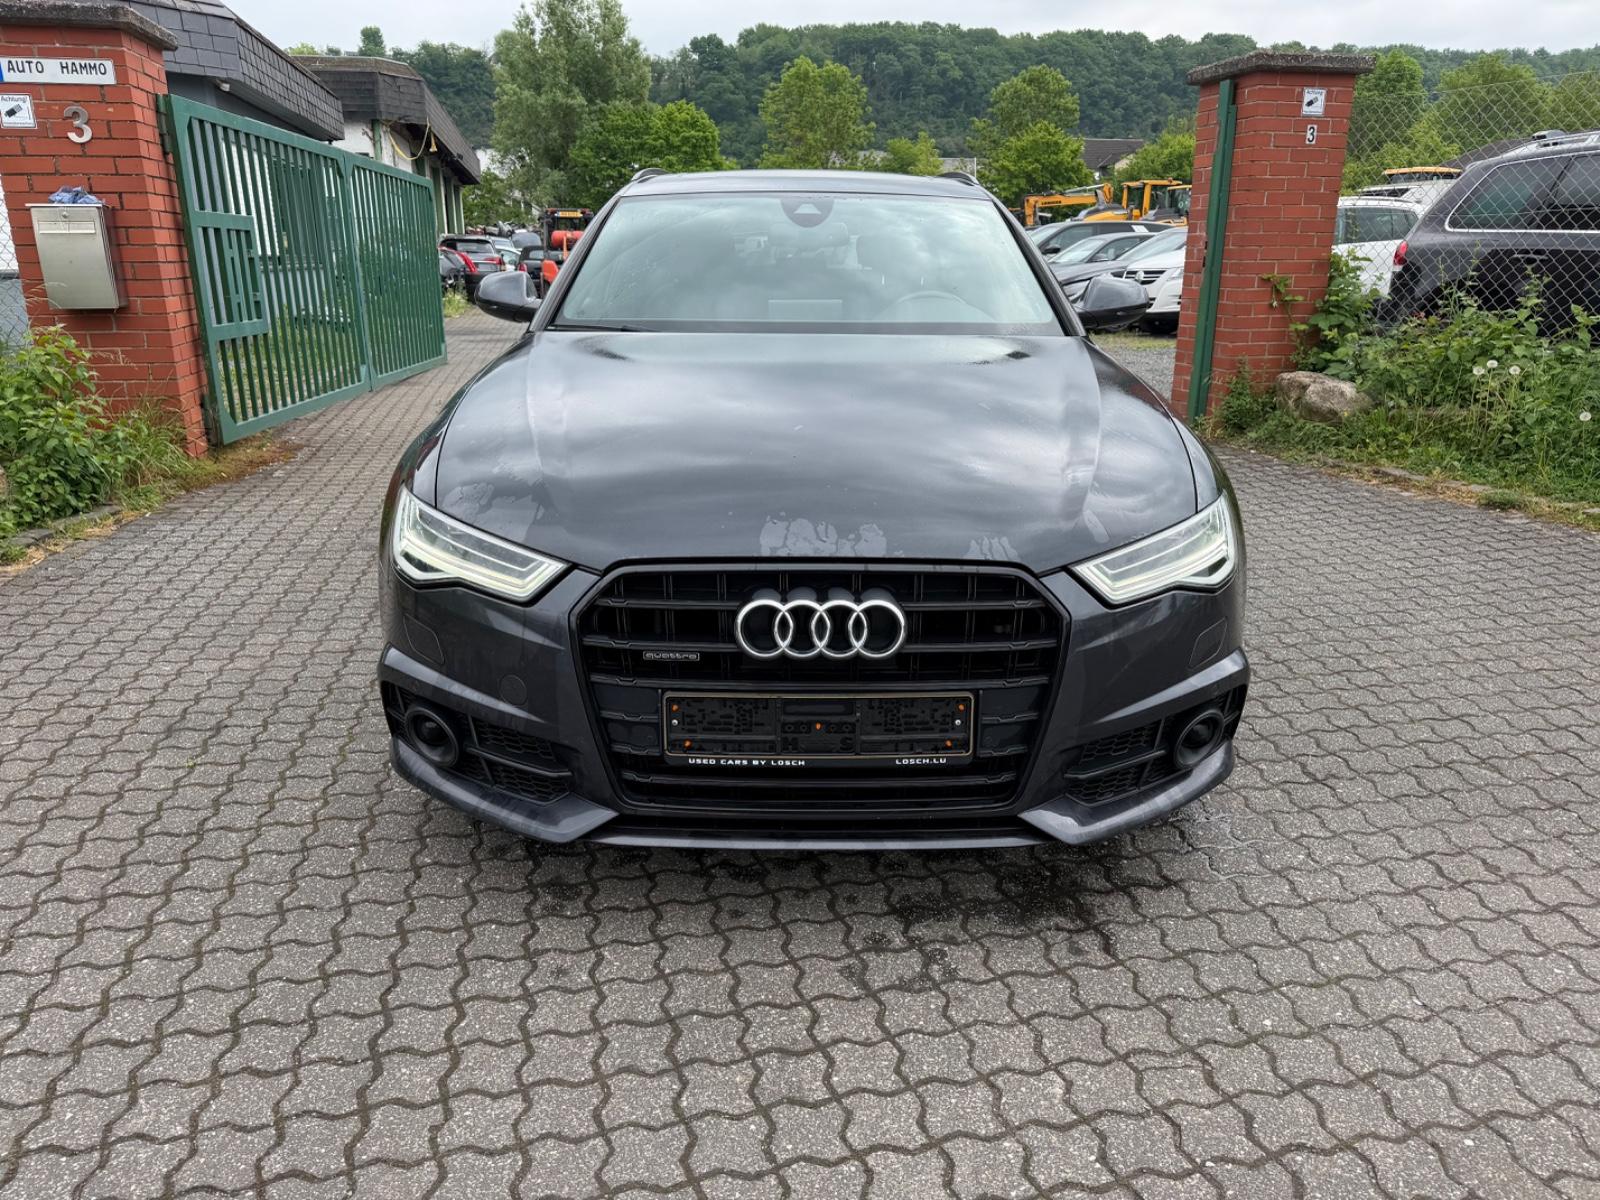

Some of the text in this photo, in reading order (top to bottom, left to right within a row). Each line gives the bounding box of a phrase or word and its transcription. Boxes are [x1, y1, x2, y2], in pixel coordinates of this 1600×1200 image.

[7, 60, 107, 76] AUTO HAMMO
[63, 105, 93, 144] 3
[1307, 126, 1316, 143] 3
